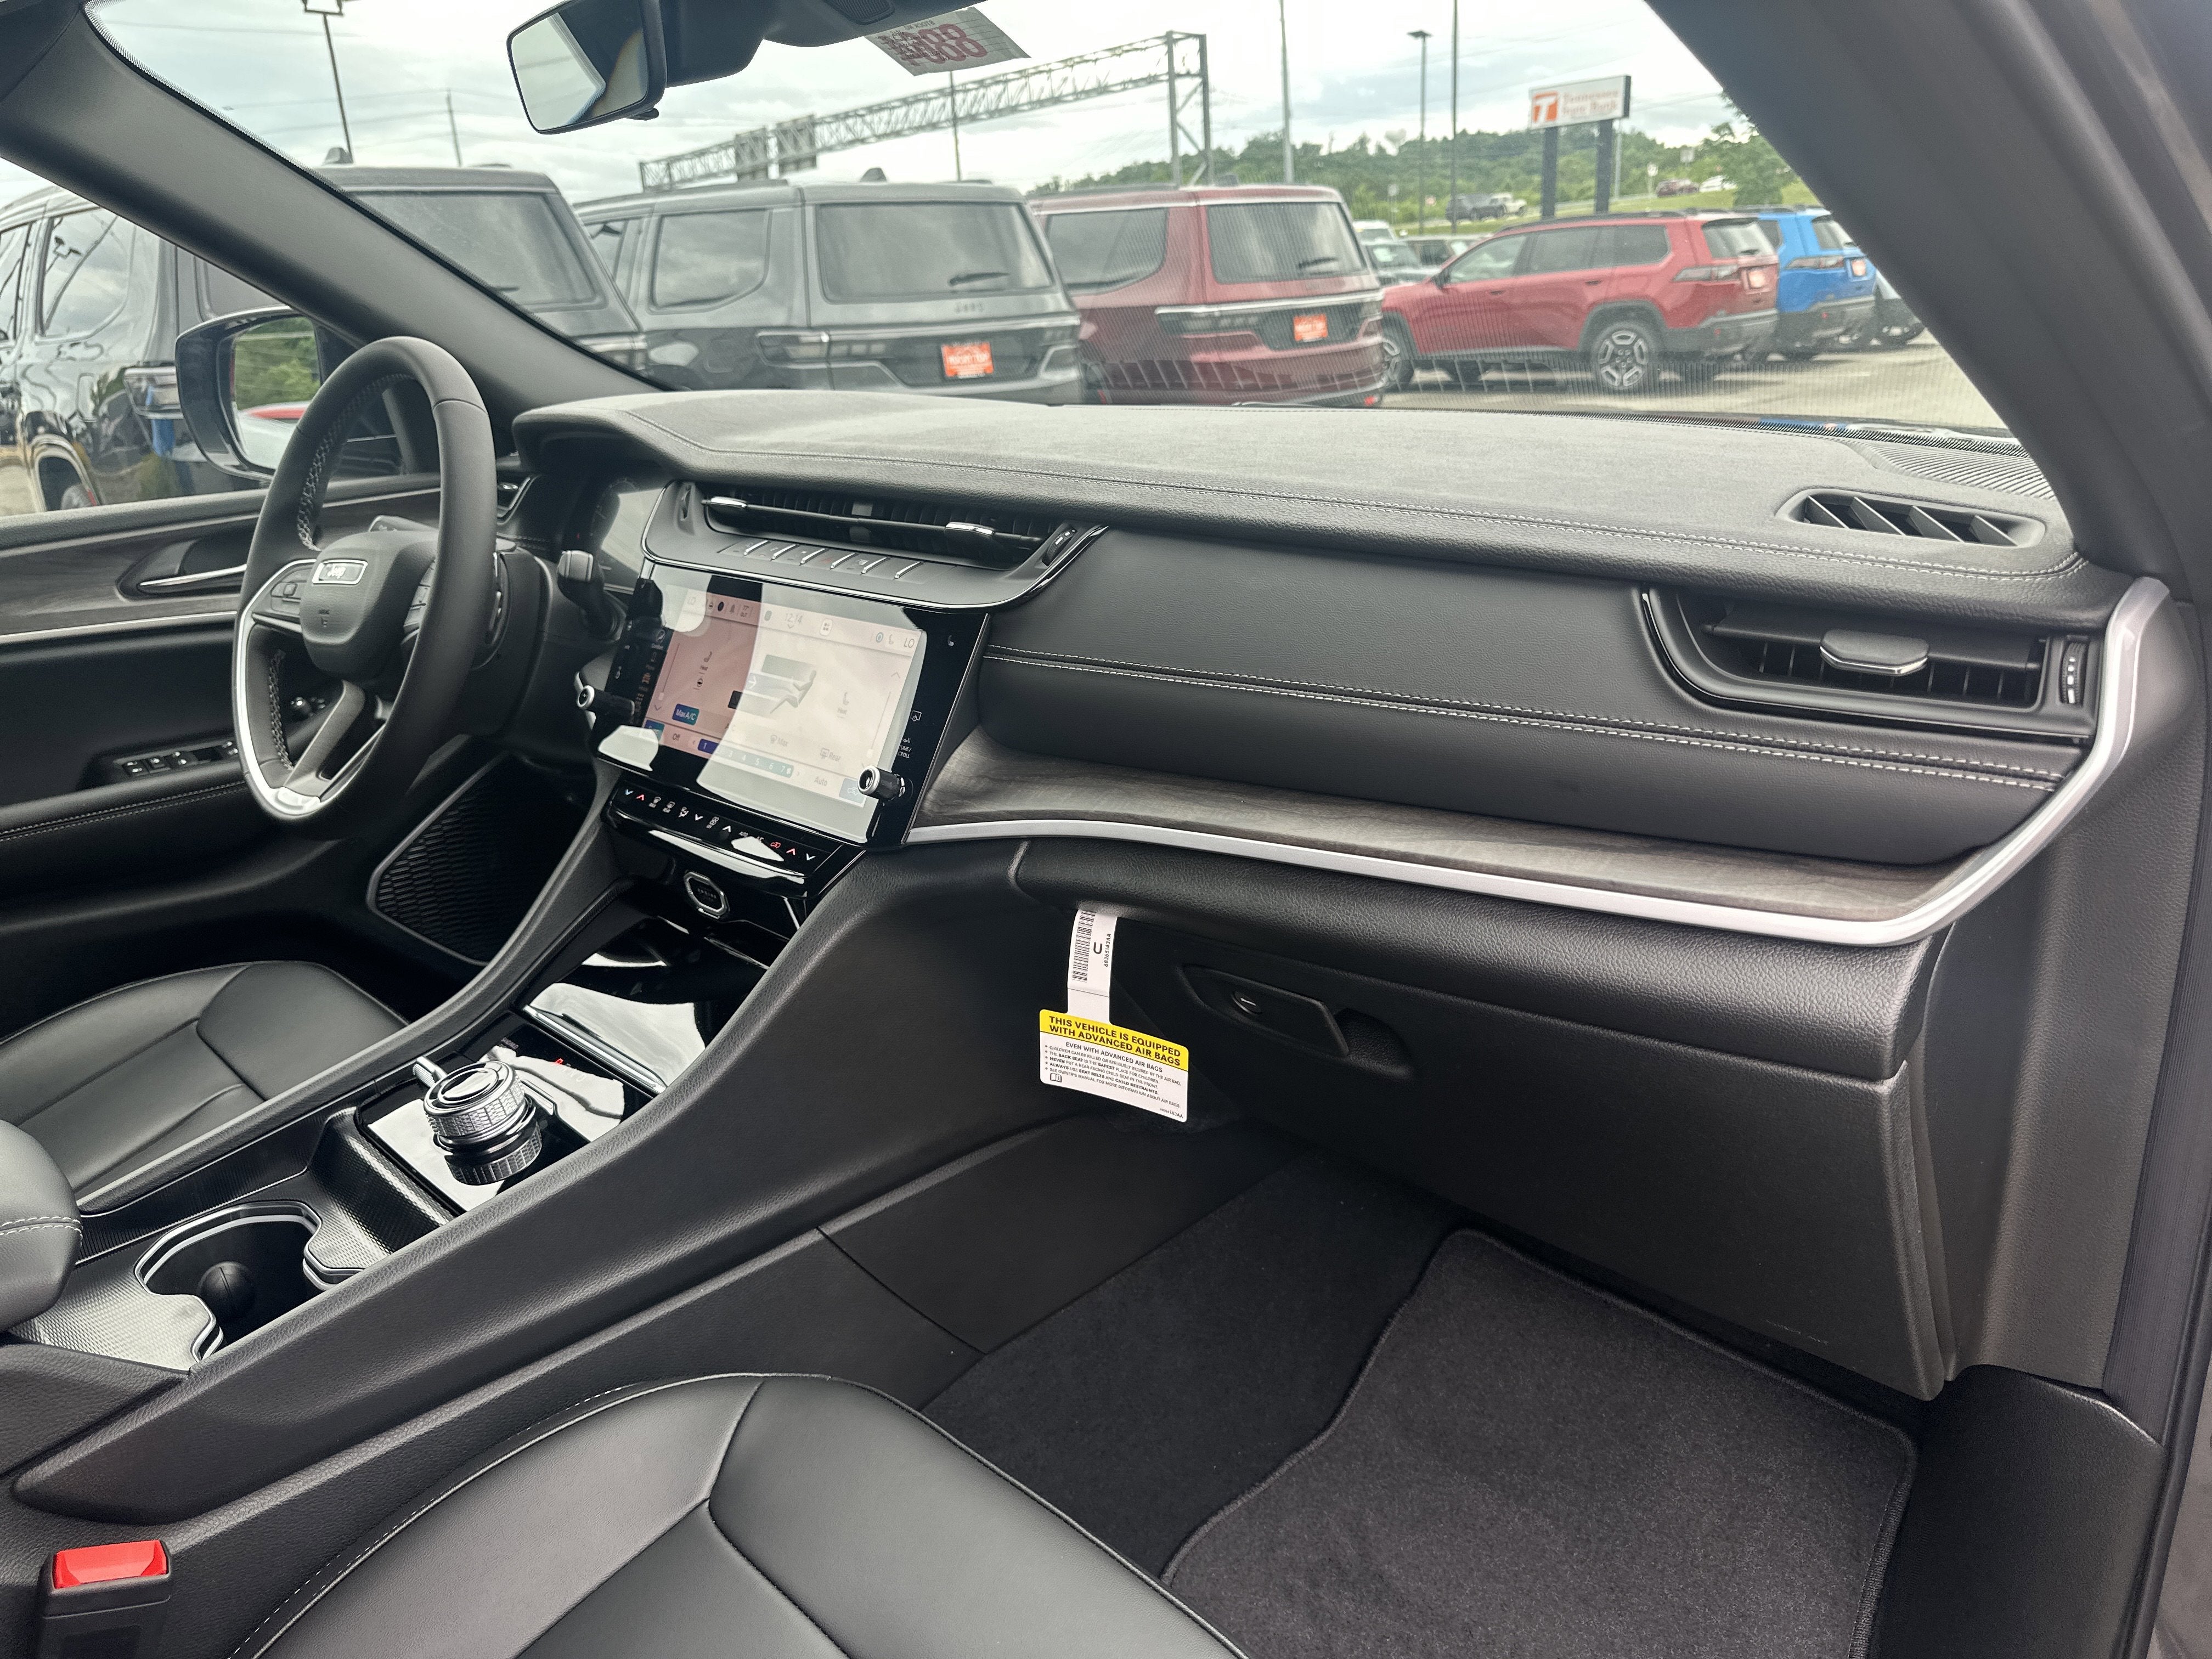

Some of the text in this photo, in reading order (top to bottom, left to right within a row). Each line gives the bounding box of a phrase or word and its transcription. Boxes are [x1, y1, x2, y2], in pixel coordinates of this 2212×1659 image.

[904, 638, 915, 648] LO
[828, 752, 841, 761] Rear
[814, 776, 828, 787] Auto
[1093, 941, 1103, 955] U
[1049, 1016, 1181, 1057] THIS VEHICLE IS EQUIPPED
[1049, 1025, 1181, 1066] WITH ADVANCED AIR BAGS
[1084, 1046, 1099, 1054] WITH
[1101, 1050, 1134, 1063] ADVANCED
[1147, 1063, 1163, 1073] BAGS
[1118, 1085, 1146, 1096] INFORMATION
